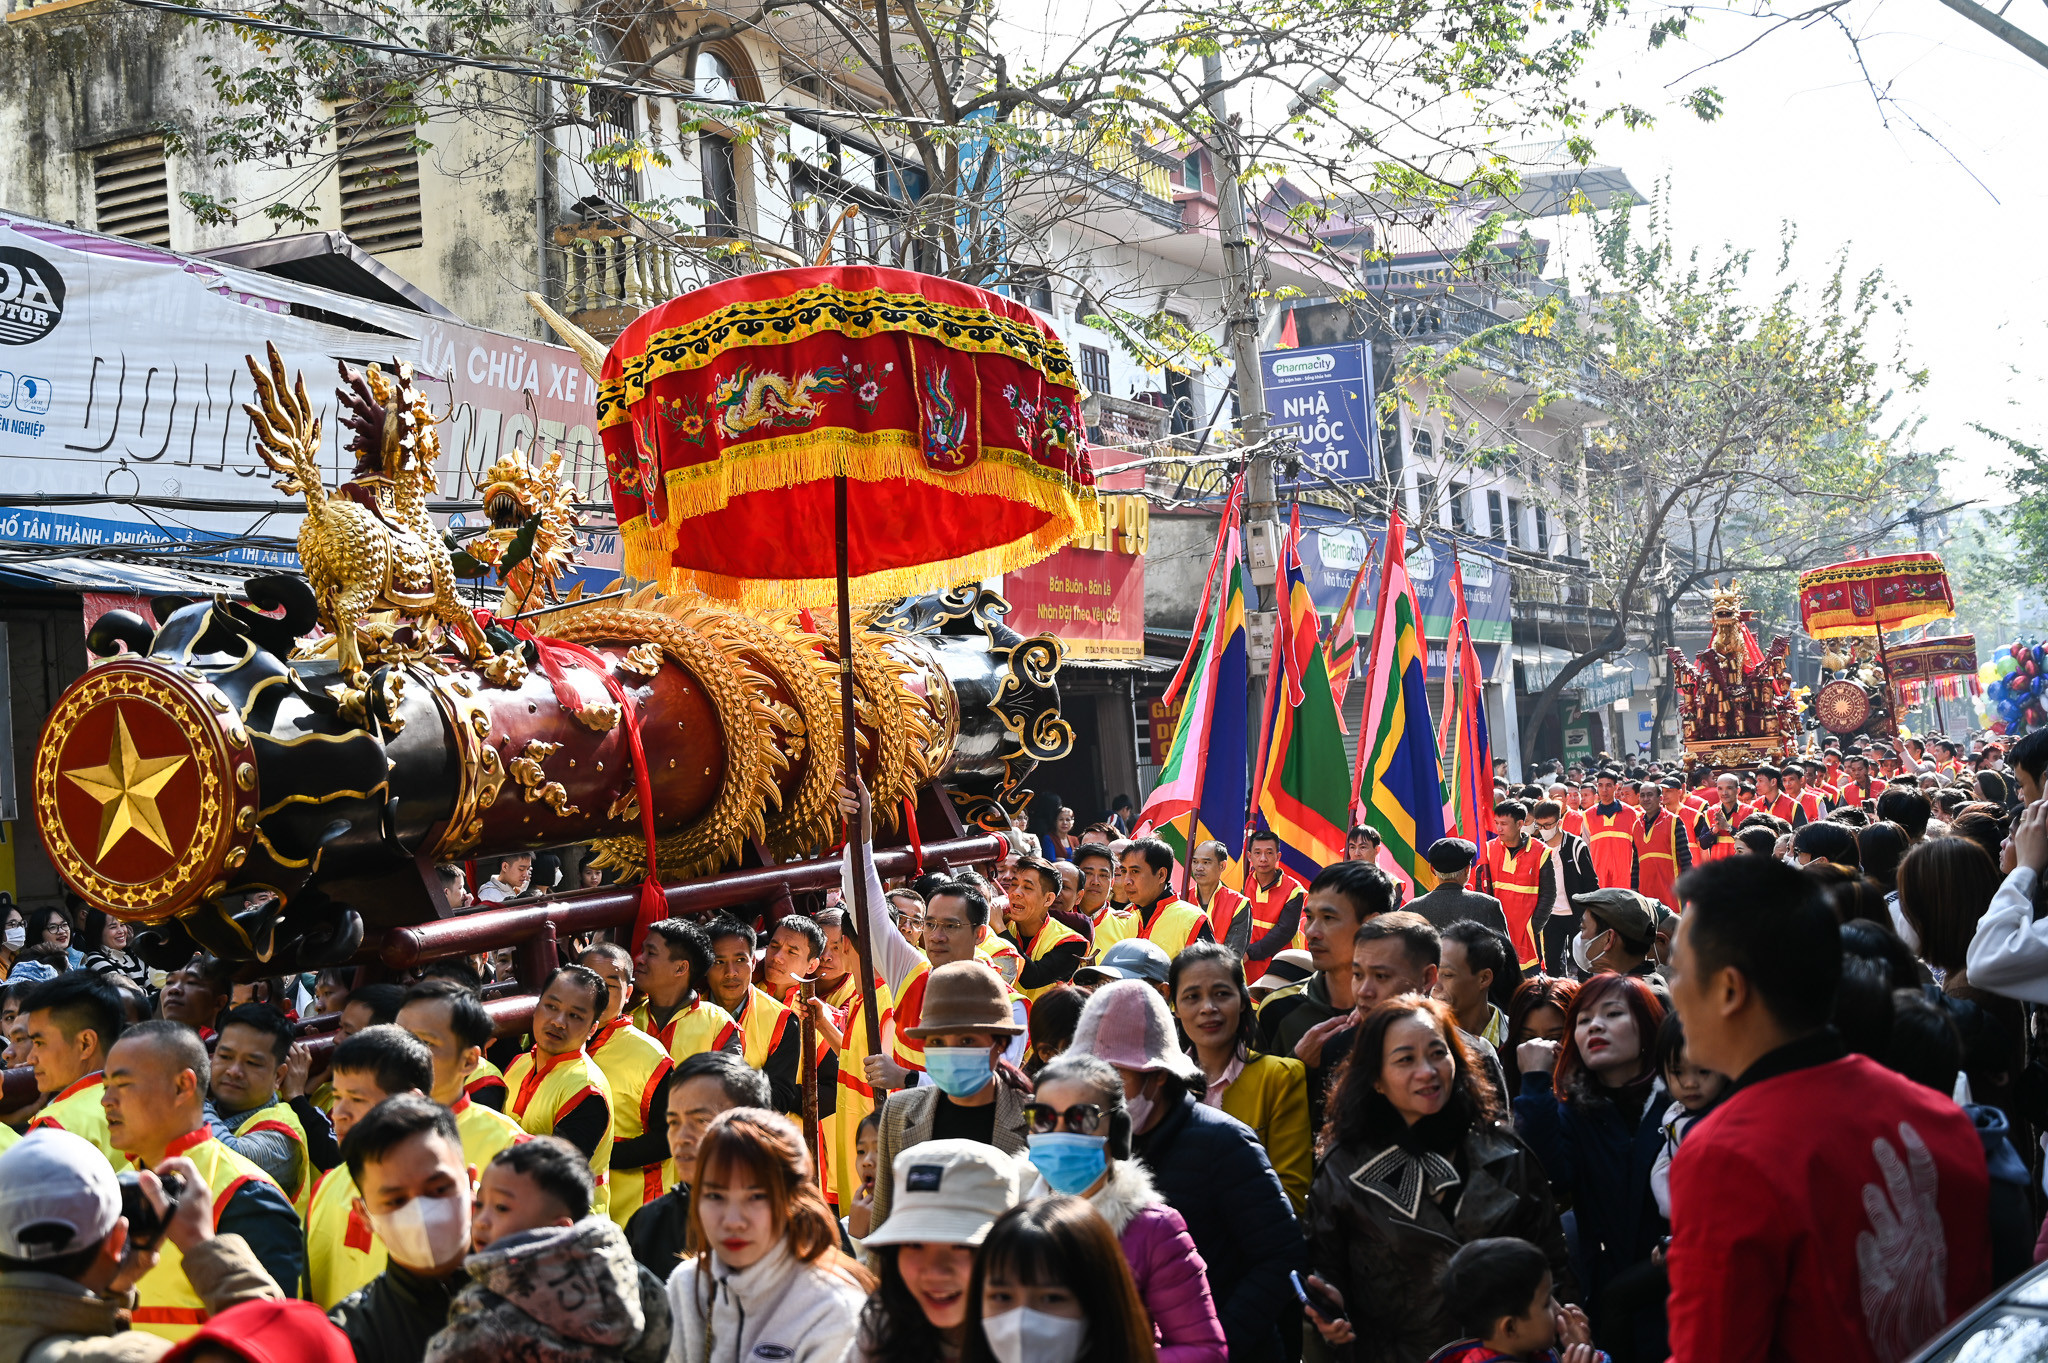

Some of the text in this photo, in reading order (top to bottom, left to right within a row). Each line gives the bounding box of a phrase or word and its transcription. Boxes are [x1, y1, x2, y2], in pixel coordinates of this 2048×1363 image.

[0, 301, 50, 327] TOR
[421, 322, 457, 382] ỬA
[467, 345, 540, 396] CHỮA
[547, 363, 579, 403] XE
[1276, 357, 1331, 374] Pharmacity
[1283, 390, 1330, 418] NHÀ
[11, 420, 45, 439] NGHIỆP
[1311, 442, 1349, 471] TỐT
[0, 512, 20, 536] HỐ
[23, 517, 51, 540] TÂN
[55, 521, 103, 544] THÀNH
[1122, 495, 1149, 556] 99
[1321, 535, 1365, 565] Pharmacity
[1049, 575, 1064, 592] Bán
[1065, 577, 1083, 594] Buôn
[1088, 579, 1102, 595] Bán
[1037, 603, 1058, 623] Nhận
[1073, 605, 1091, 621] Theo
[1091, 606, 1105, 622] Yêu
[1106, 602, 1121, 623] Cầu
